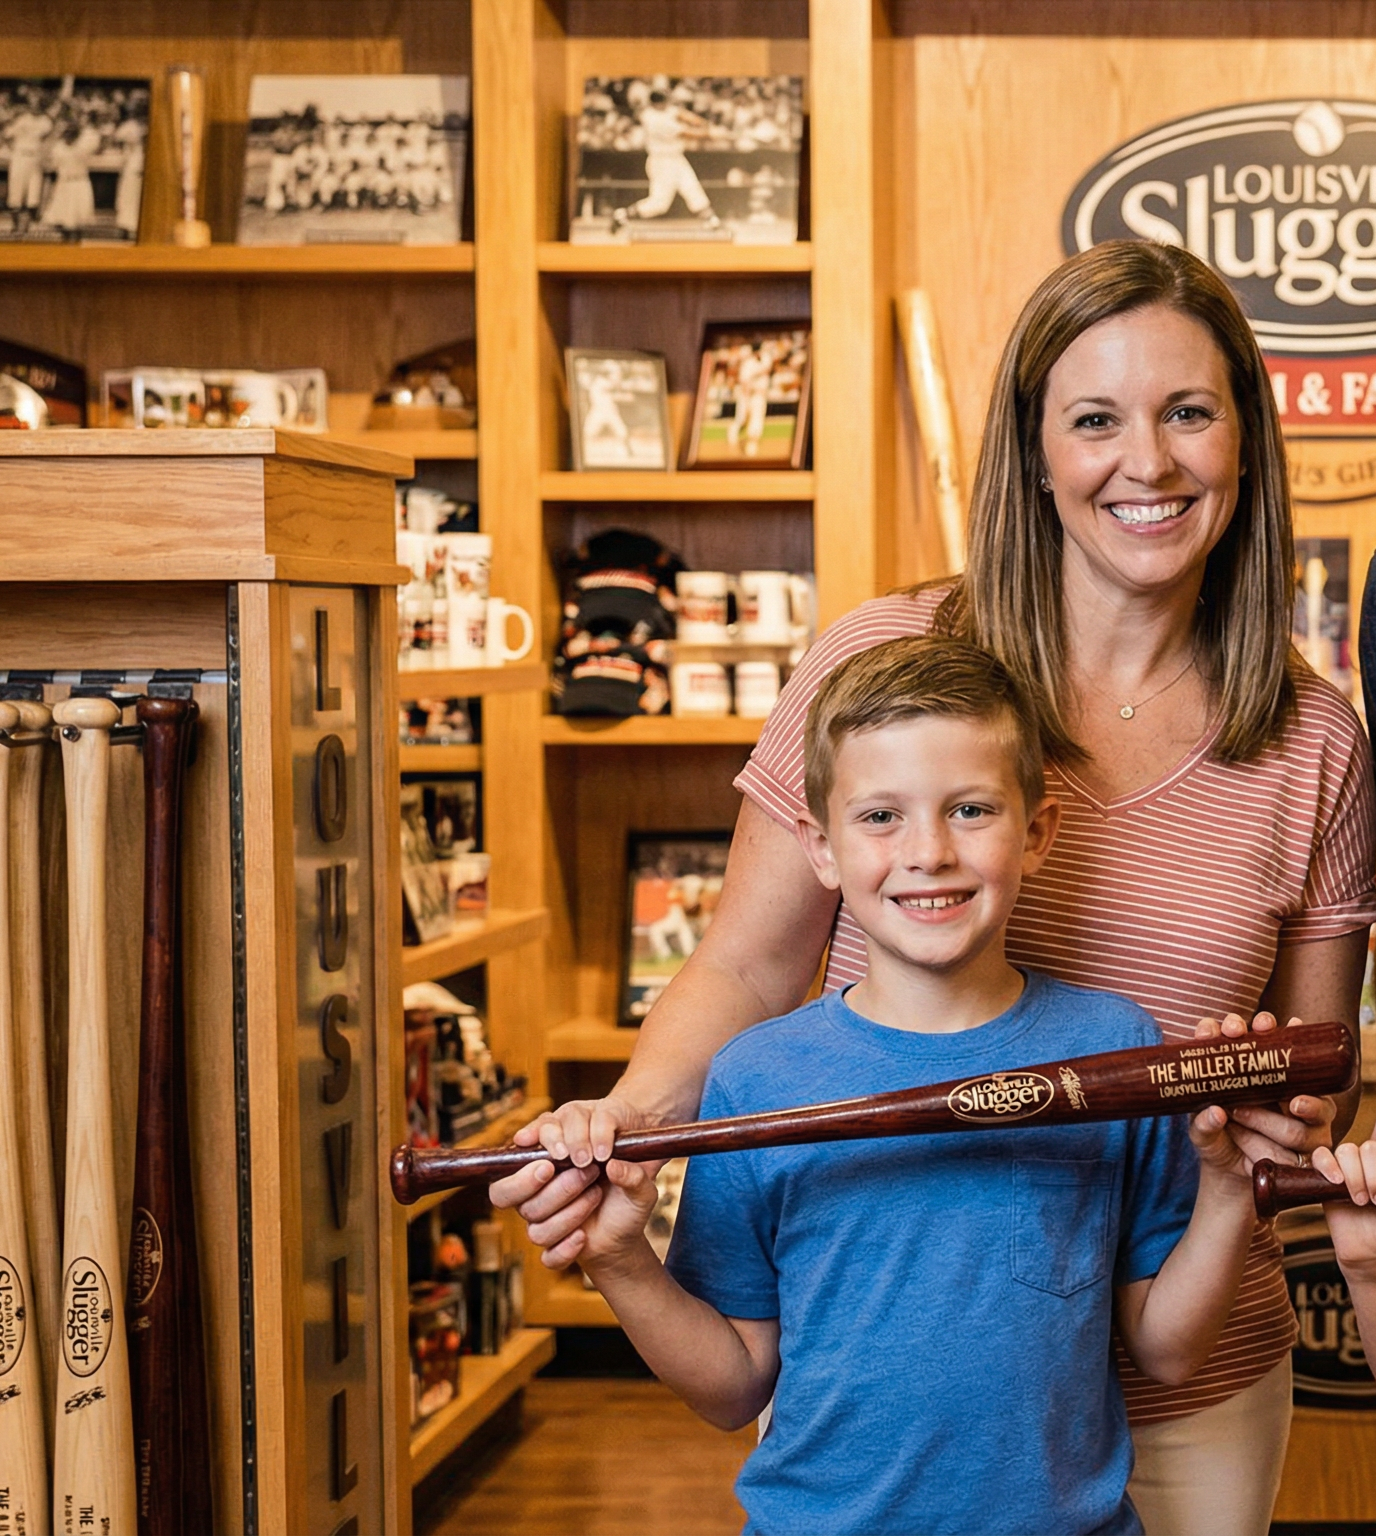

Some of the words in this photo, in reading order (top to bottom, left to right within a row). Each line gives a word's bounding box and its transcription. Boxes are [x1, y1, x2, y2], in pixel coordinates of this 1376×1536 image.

[1296, 371, 1332, 416] &
[313, 606, 358, 1536] LOUSVIL
[1147, 1063, 1178, 1085] THE
[1180, 1055, 1236, 1081] MILLER
[1238, 1048, 1293, 1074] FAMILY
[958, 1085, 1046, 1114] Slugger
[66, 1270, 99, 1366] Slugger
[79, 1505, 94, 1527] THE
